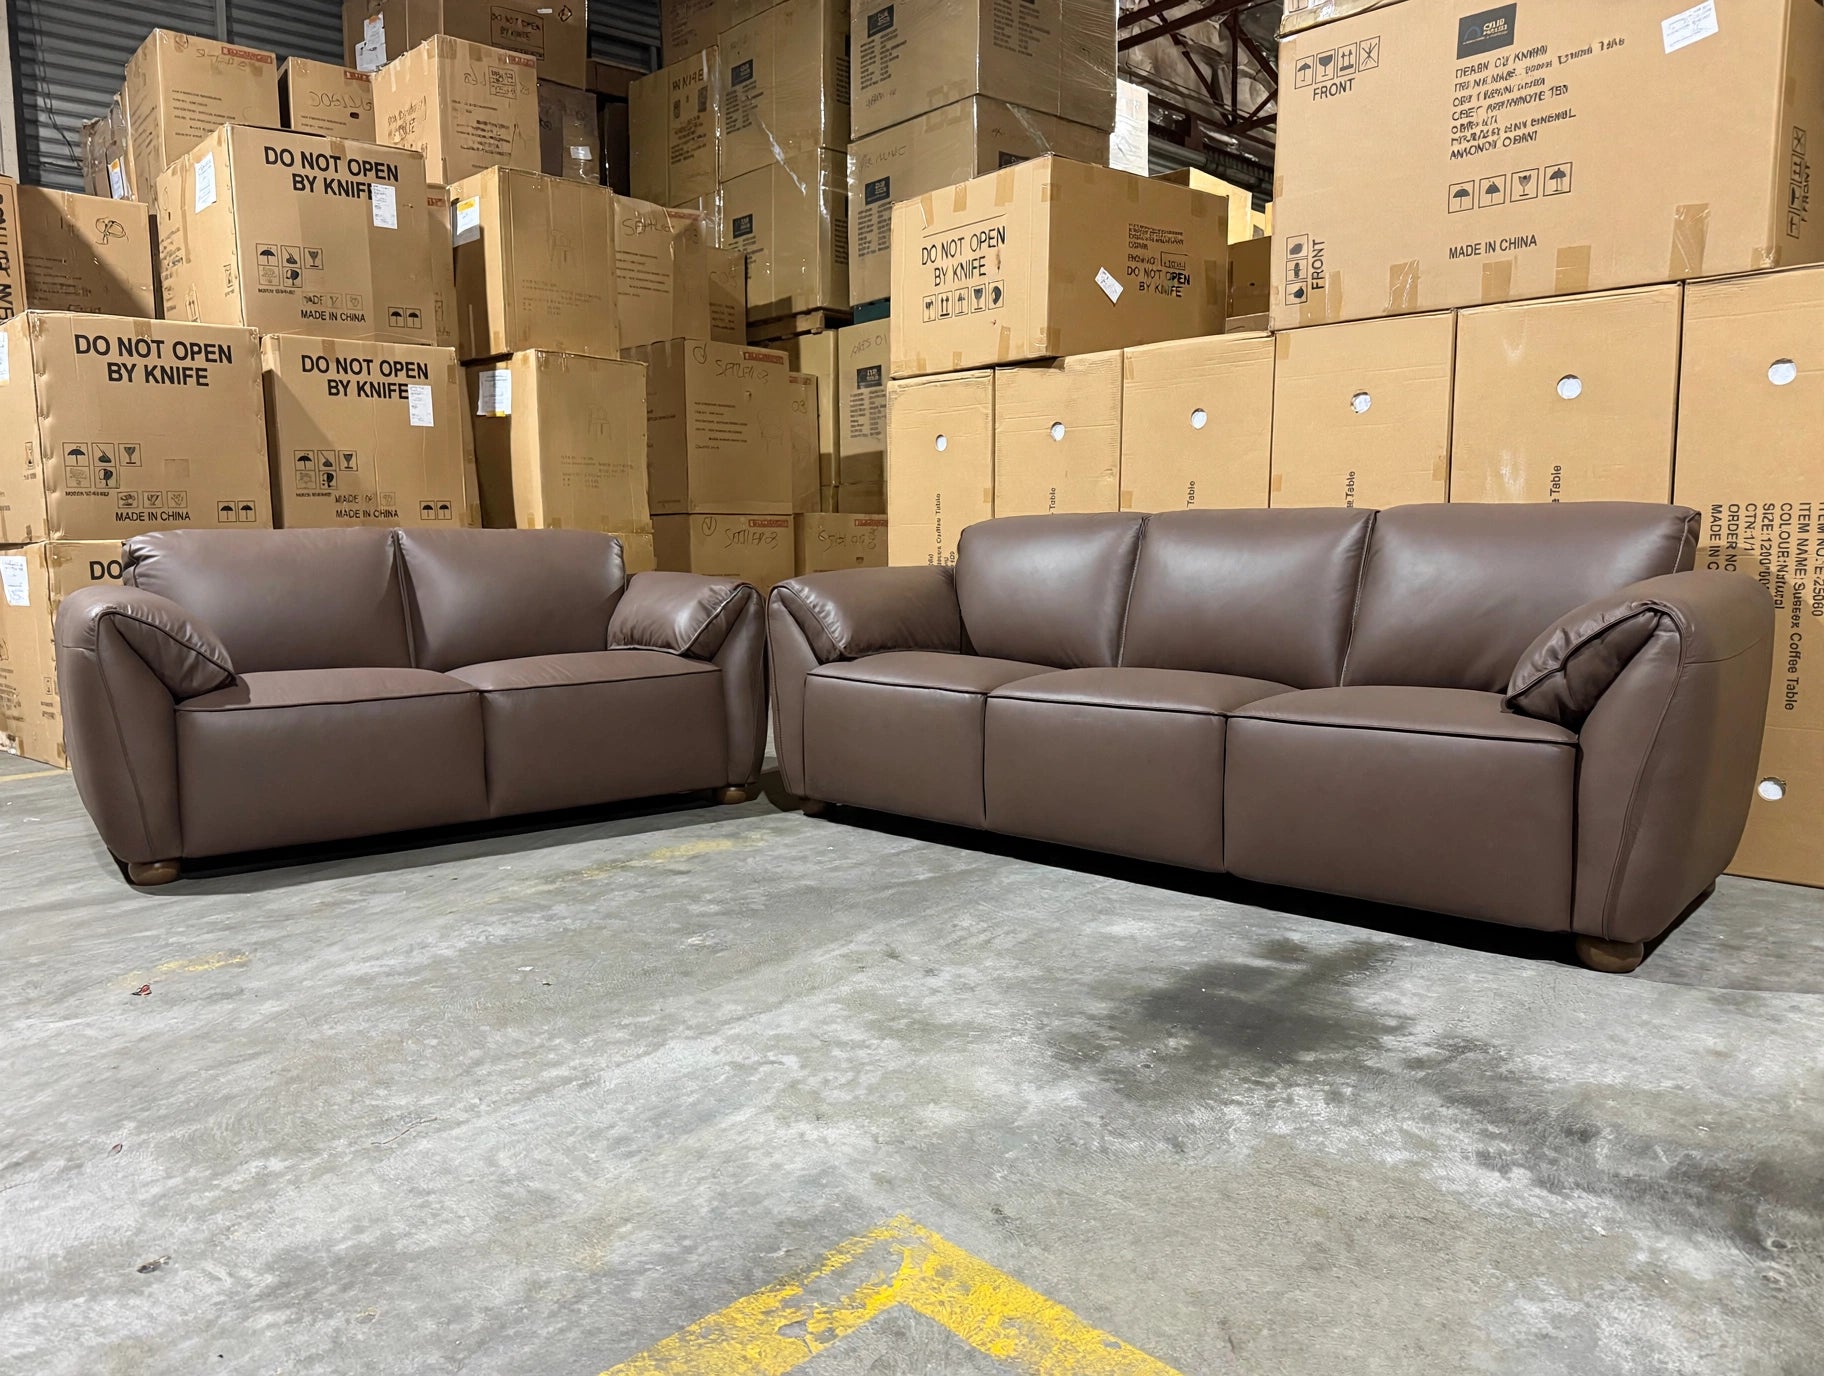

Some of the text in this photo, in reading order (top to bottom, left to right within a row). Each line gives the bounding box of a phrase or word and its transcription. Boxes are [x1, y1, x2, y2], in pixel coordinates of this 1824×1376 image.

[1313, 77, 1355, 101] FRONT
[264, 146, 399, 183] DO NOT OPEN
[292, 173, 317, 193] BY
[921, 225, 1005, 266] DO NOT OPEN
[1448, 234, 1538, 260] MADE IN CHINA
[934, 256, 987, 287] BY KNIFE
[1127, 266, 1191, 286] DO NOT OPEN
[1311, 239, 1326, 291] FRONT
[1139, 281, 1184, 298] BY KNIFE
[301, 309, 367, 324] MADE IN CHINA
[74, 334, 233, 364] DO NOT OPEN
[107, 362, 209, 387] BY KNIFE
[301, 354, 429, 380] DO NOT OPEN
[327, 379, 409, 400] BY KNIFE
[1187, 480, 1196, 508] Table
[1345, 471, 1356, 500] Table
[1550, 465, 1562, 496] Table
[115, 511, 191, 522] MADE IN CHINA
[336, 509, 399, 519] MADE IN CHINA
[1708, 504, 1723, 541] MADE
[1726, 503, 1740, 550] ORDER
[1743, 503, 1757, 551] CTN:1/1
[1797, 502, 1812, 533] ITEM
[1708, 545, 1721, 557] IN
[89, 560, 122, 581] DO
[1787, 632, 1802, 673] Coffee
[1784, 677, 1799, 710] Table
